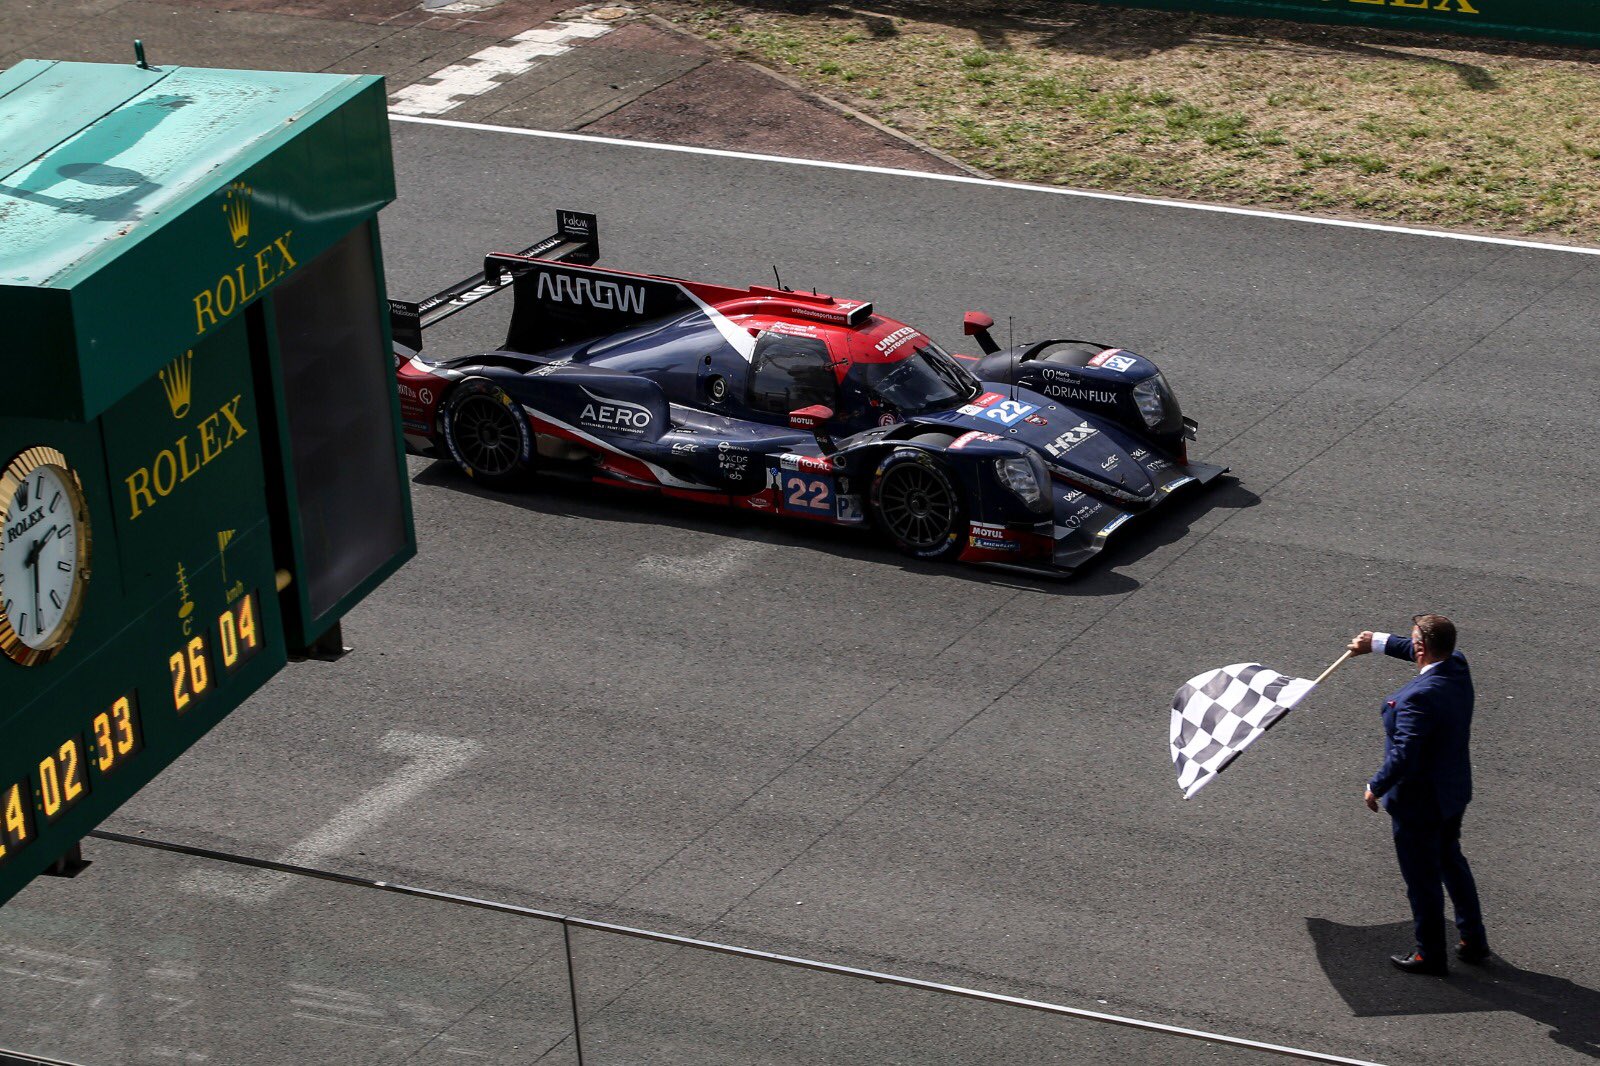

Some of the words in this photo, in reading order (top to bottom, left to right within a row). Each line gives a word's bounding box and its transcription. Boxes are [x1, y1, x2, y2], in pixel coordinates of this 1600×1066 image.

[192, 230, 297, 335] ROLEX
[537, 272, 645, 314] ARROW
[875, 326, 915, 352] UNITED
[883, 332, 921, 357] AUTOSPORTS
[1106, 356, 1131, 370] P2
[579, 403, 650, 428] AERO
[790, 416, 814, 425] MOTUL
[986, 400, 1033, 423] 22
[672, 442, 699, 453] WEC
[1044, 420, 1097, 457] HRX
[124, 394, 248, 520] ROLEX
[801, 460, 831, 471] TOTAL
[1101, 454, 1119, 469] WEC
[787, 477, 831, 510] 22
[6, 505, 46, 543] ROLEX
[972, 527, 1004, 539] MOTUL
[218, 593, 256, 668] 04
[169, 635, 209, 711] 26
